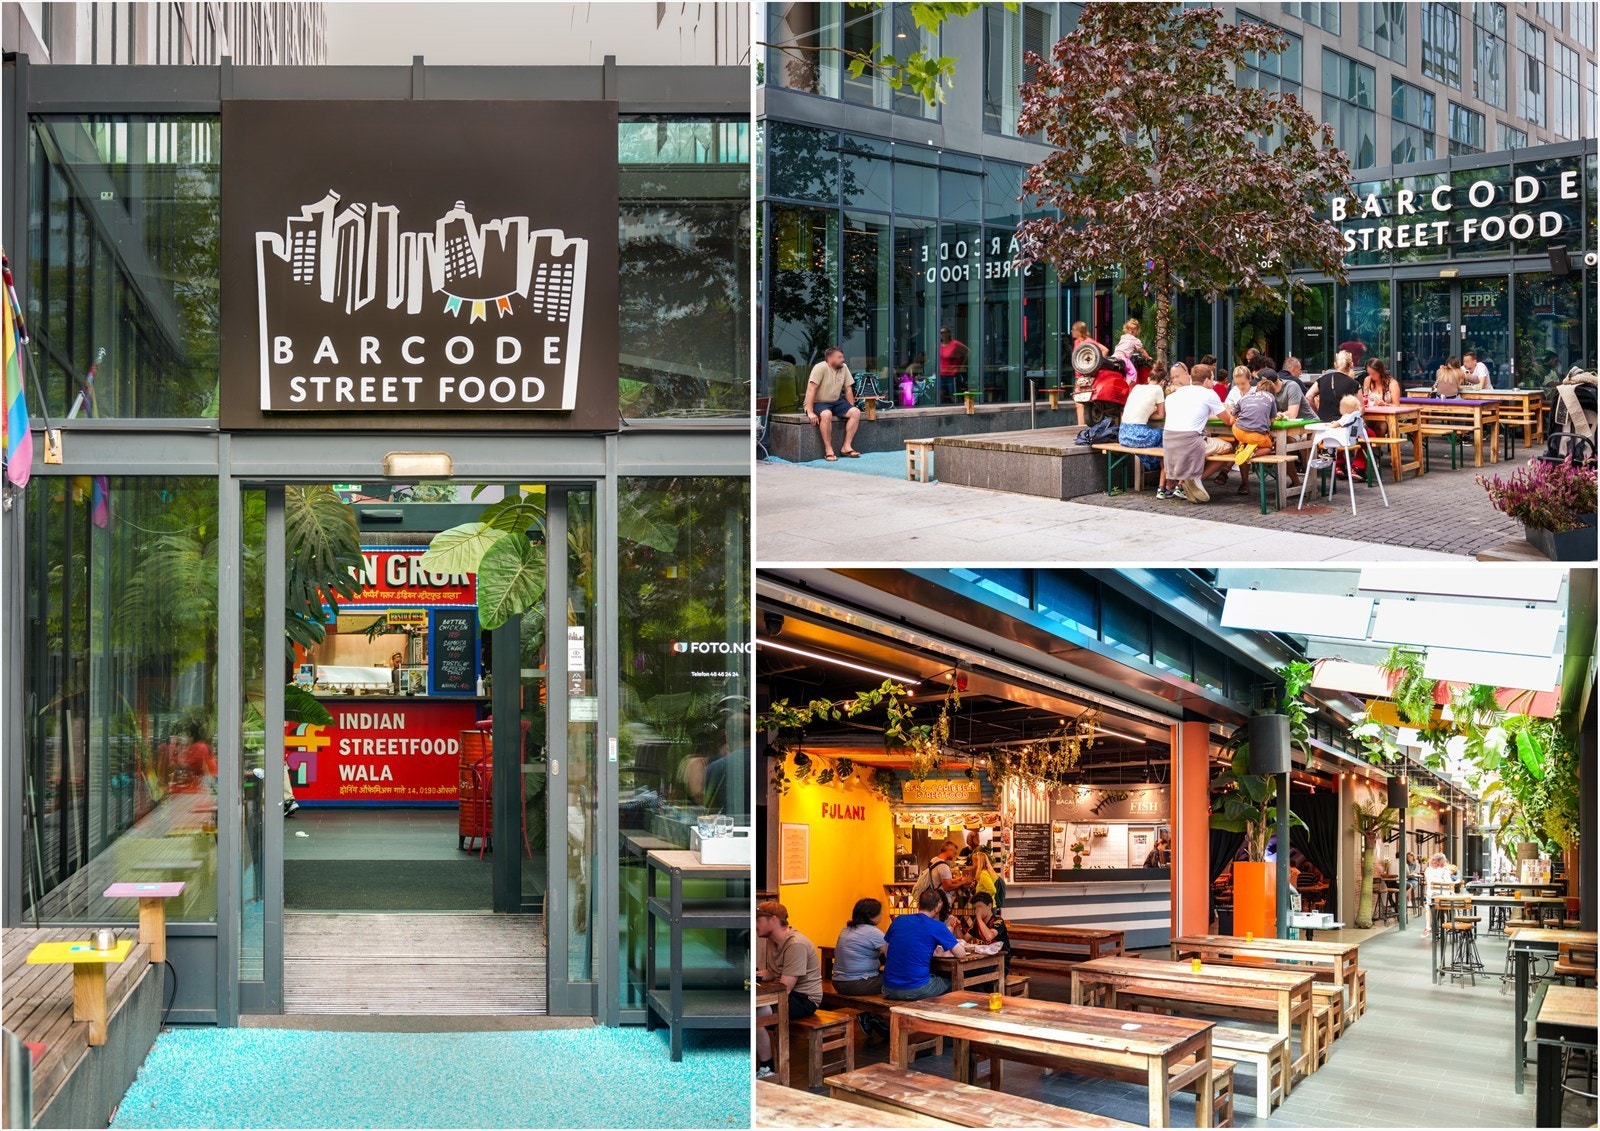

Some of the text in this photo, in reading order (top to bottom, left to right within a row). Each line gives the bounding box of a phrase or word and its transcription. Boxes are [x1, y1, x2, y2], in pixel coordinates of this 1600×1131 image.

[1331, 170, 1580, 221] BARCODE
[1343, 211, 1563, 252] STREET FOOD
[273, 335, 562, 365] BARCODE
[289, 376, 546, 403] STREET FOOD
[339, 712, 405, 730] INDIAN
[339, 738, 460, 756] STREETFOOD
[338, 764, 394, 782] WALA
[822, 801, 865, 821] FULANI
[1130, 801, 1158, 811] FISH
